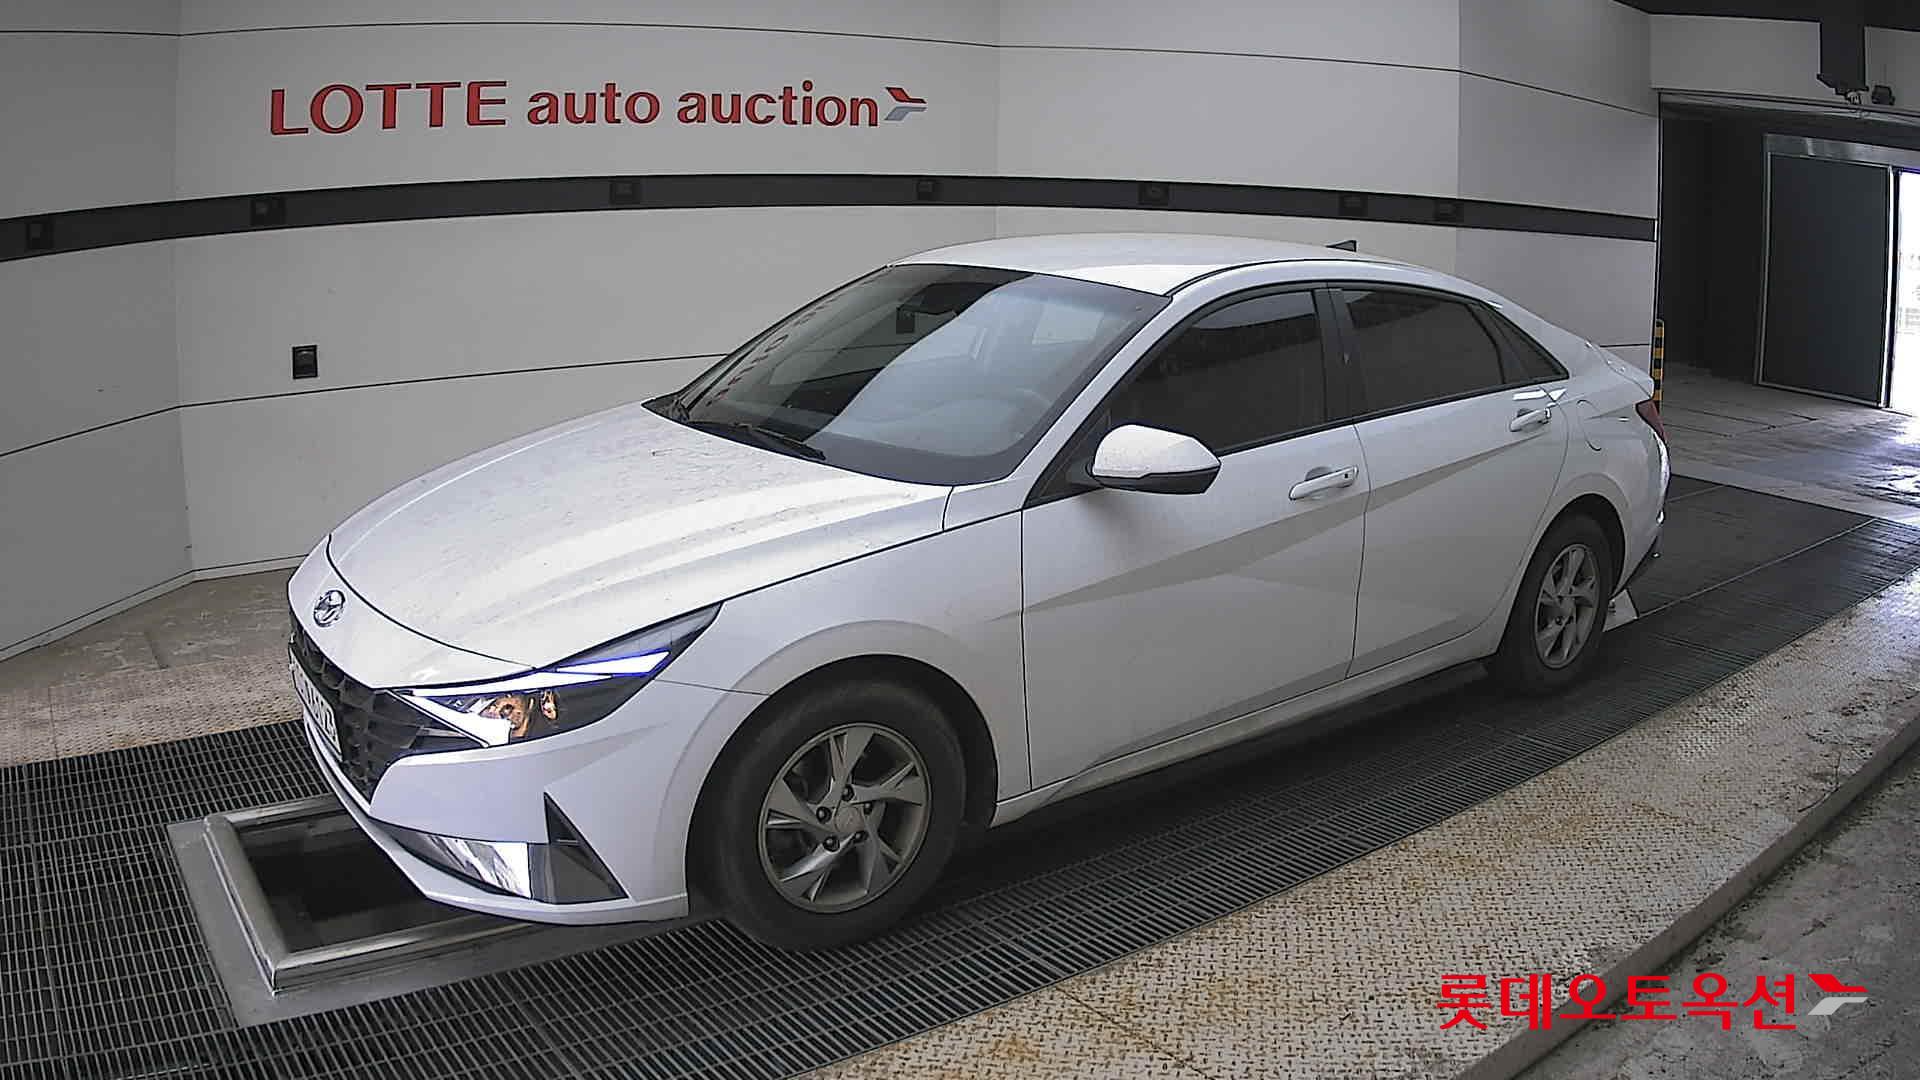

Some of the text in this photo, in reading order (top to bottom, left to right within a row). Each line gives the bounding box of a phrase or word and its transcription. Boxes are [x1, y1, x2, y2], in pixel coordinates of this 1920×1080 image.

[270, 79, 879, 135] LOTTE auto auction
